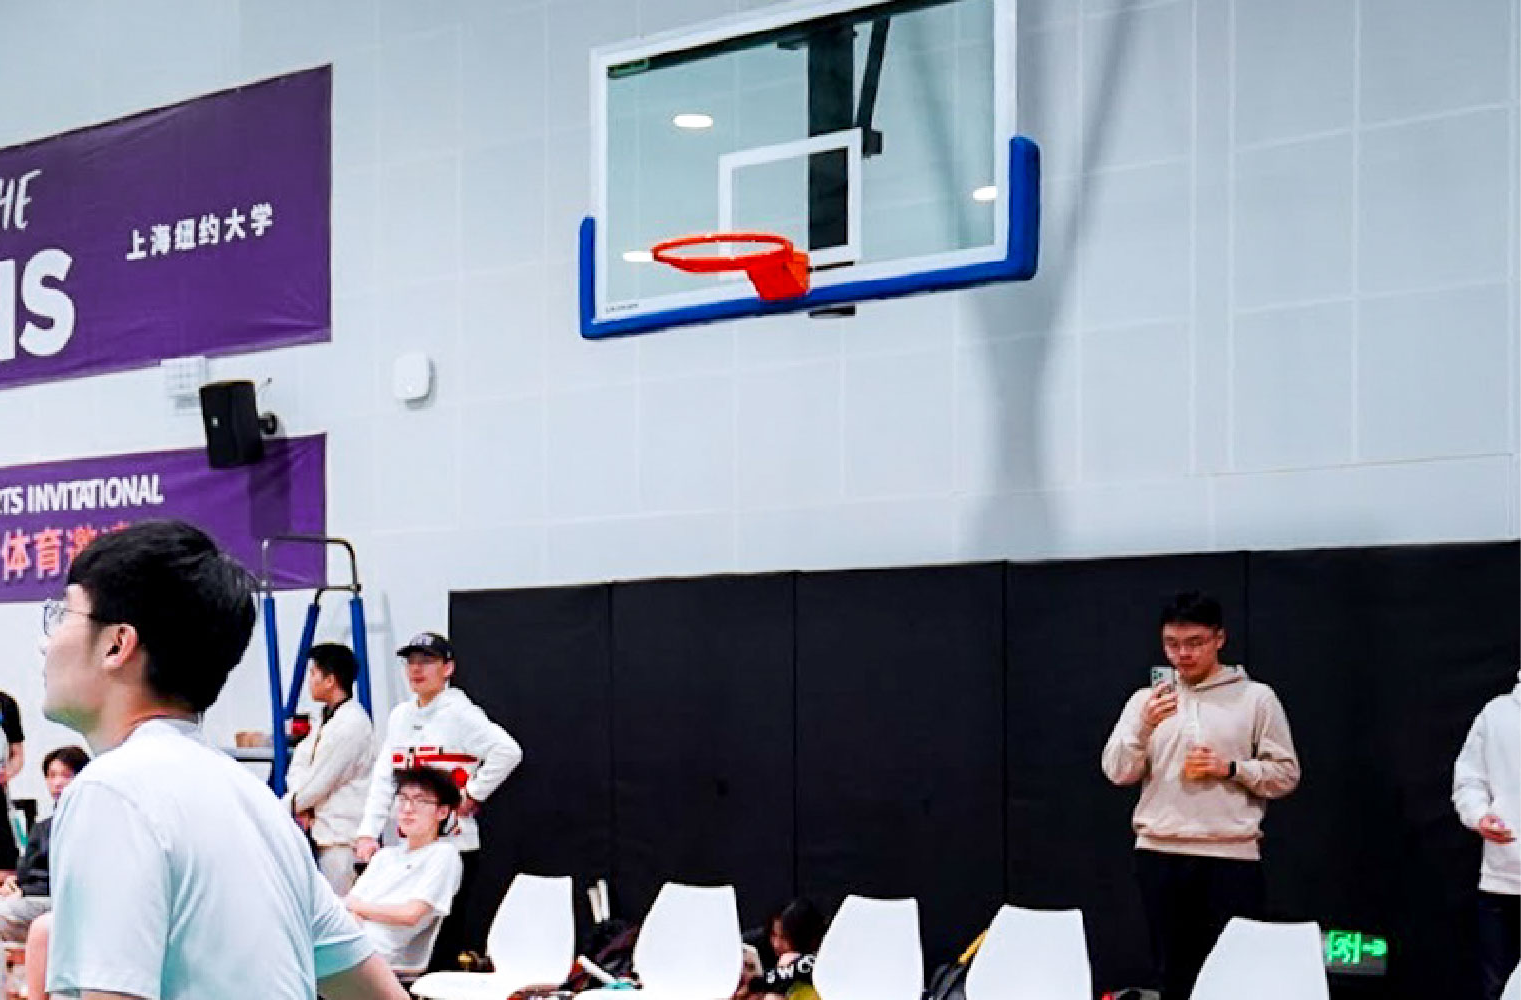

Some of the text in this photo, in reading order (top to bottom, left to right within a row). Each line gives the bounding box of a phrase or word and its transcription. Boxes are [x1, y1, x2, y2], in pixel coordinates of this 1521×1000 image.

[125, 202, 274, 261] 上海纽约大学
[26, 472, 165, 515] INVITATIONAL
